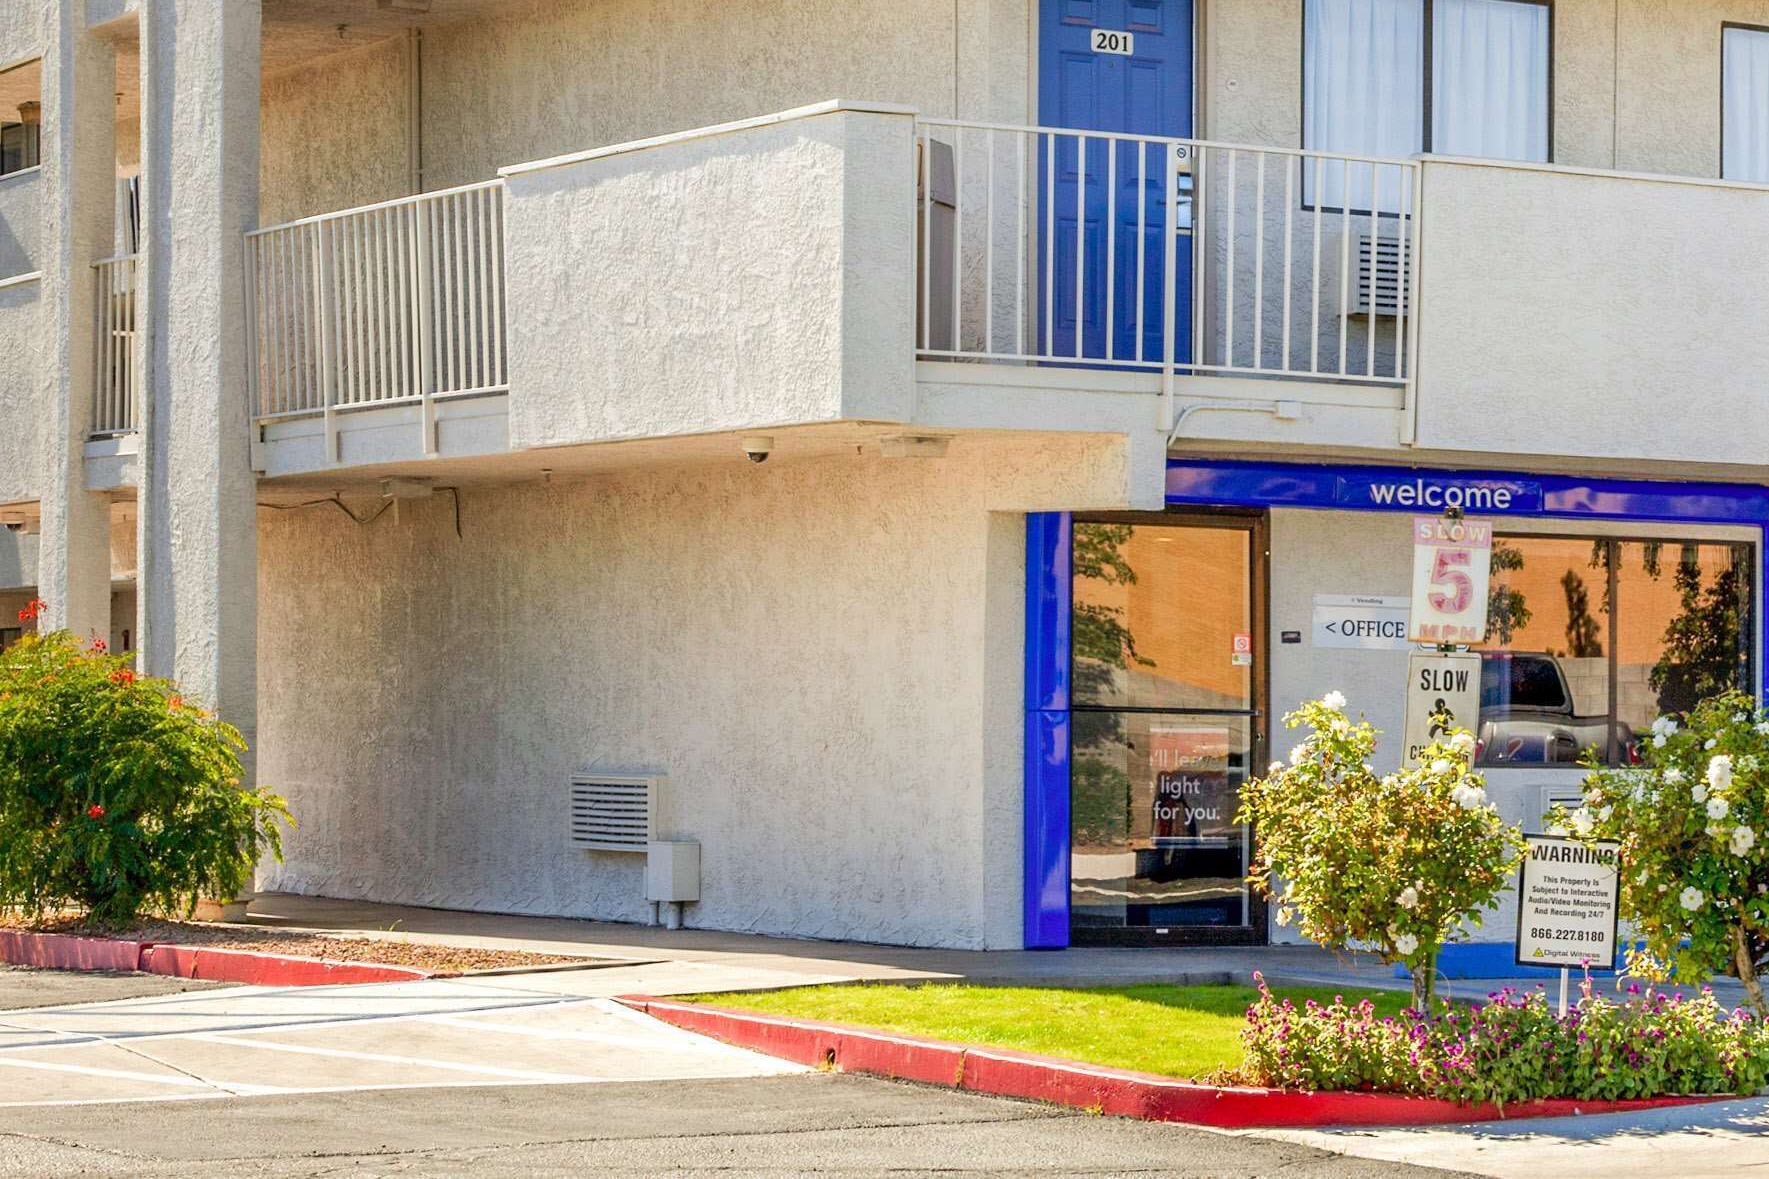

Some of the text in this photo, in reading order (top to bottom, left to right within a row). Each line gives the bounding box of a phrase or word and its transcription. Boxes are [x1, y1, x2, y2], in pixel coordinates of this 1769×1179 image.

[1096, 32, 1128, 52] 201
[1370, 478, 1512, 509] welcome
[1420, 523, 1486, 541] SLOW
[1427, 547, 1474, 614] 5
[1341, 619, 1405, 638] OFFICE
[1419, 623, 1477, 640] MPH
[1420, 668, 1469, 693] SLOW
[1160, 775, 1201, 799] light
[1153, 801, 1221, 826] for you.
[1543, 875, 1558, 883] This
[1560, 877, 1591, 887] Property
[1532, 885, 1609, 897] Subject to Interactive
[1528, 896, 1611, 910] Audio/Video Monitoring
[1534, 907, 1605, 919] And Recording 24/7
[1531, 927, 1605, 942] 866.227.8180
[1543, 949, 1601, 958] Digital Witness
